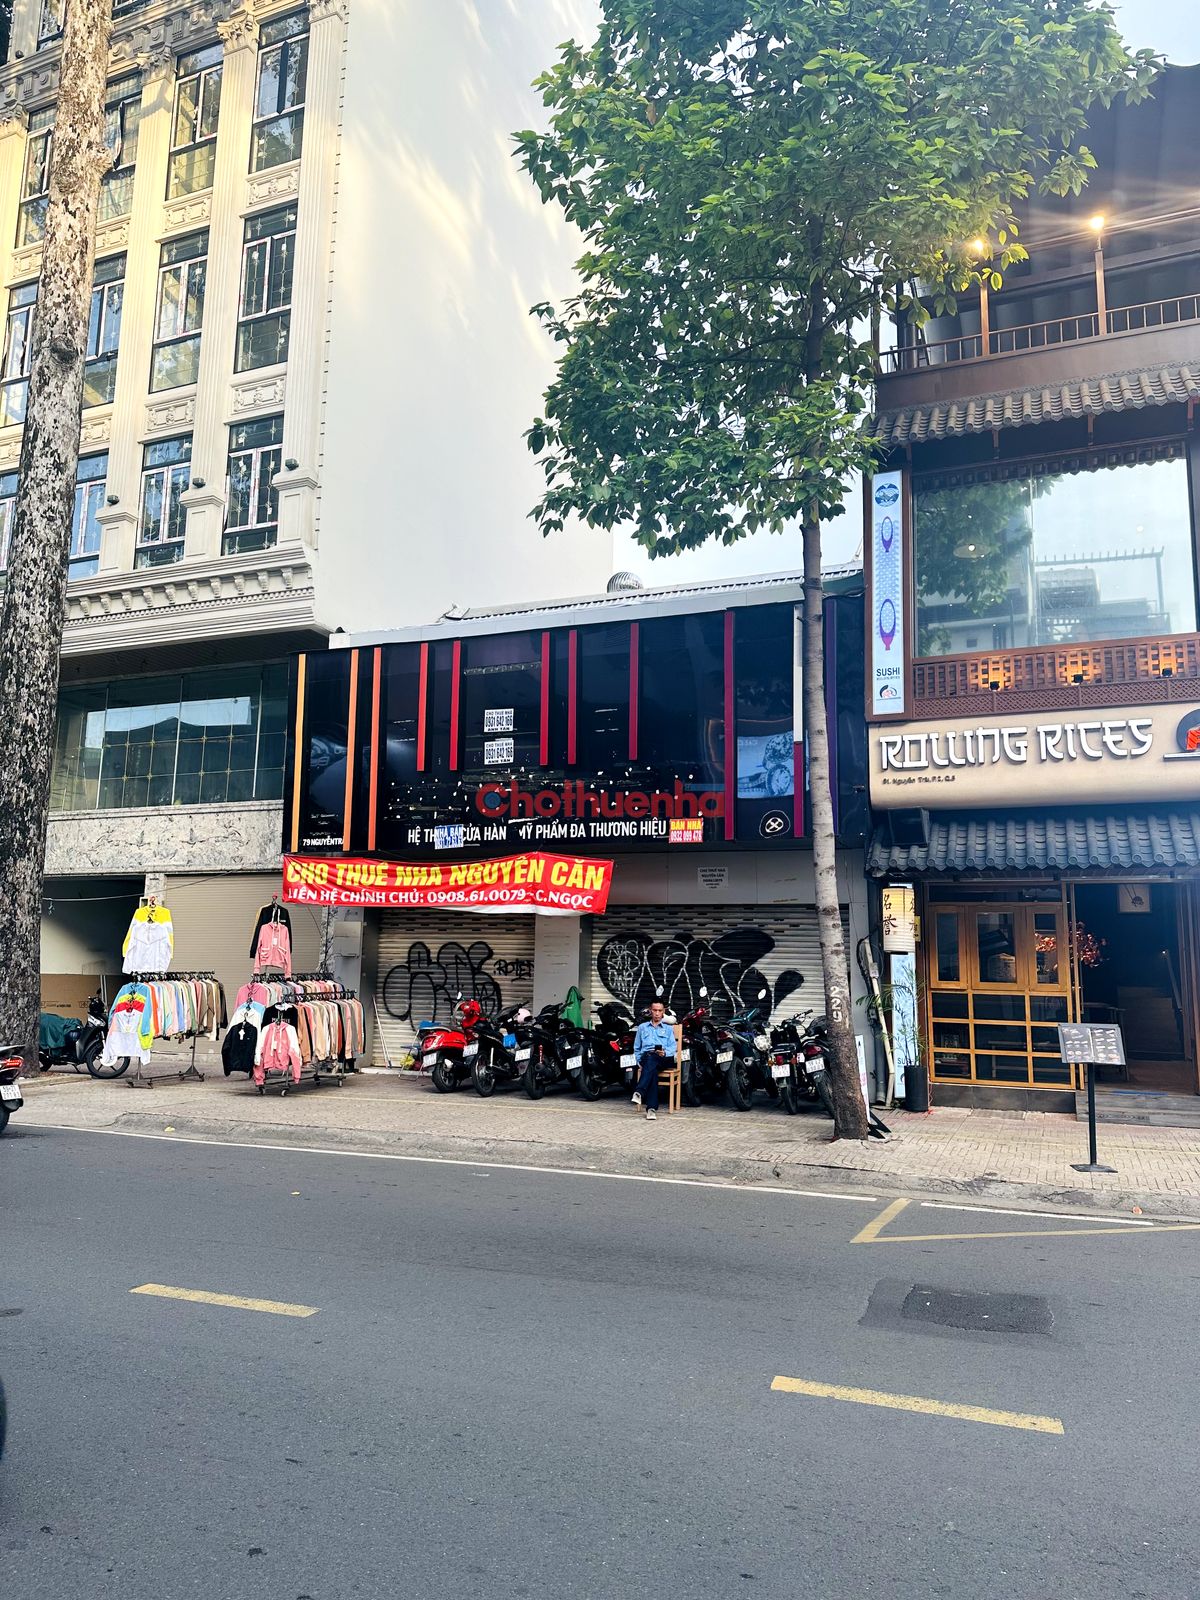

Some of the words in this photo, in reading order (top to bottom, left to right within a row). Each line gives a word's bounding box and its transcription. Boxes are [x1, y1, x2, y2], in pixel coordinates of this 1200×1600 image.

[876, 667, 900, 677] SUSHI
[879, 727, 1027, 770] ROLLING
[1037, 719, 1153, 761] RICES
[407, 826, 421, 846] HỆ
[462, 822, 481, 841] CỬA
[535, 818, 567, 839] PHẨM
[570, 822, 586, 837] ĐA
[590, 820, 637, 837] THƯƠNG
[640, 817, 667, 838] HIỆU
[286, 862, 328, 885] CHO
[335, 862, 389, 887] THUÊ
[395, 864, 443, 887] NHÀ
[449, 856, 545, 886] NGUYÊN
[551, 859, 605, 891] CĂN
[288, 887, 318, 901] LIÊN
[320, 888, 340, 905] HỆ
[340, 888, 387, 904] CHÍNH
[389, 888, 424, 904] CHỦ:
[427, 888, 527, 904] 0908.61.0079
